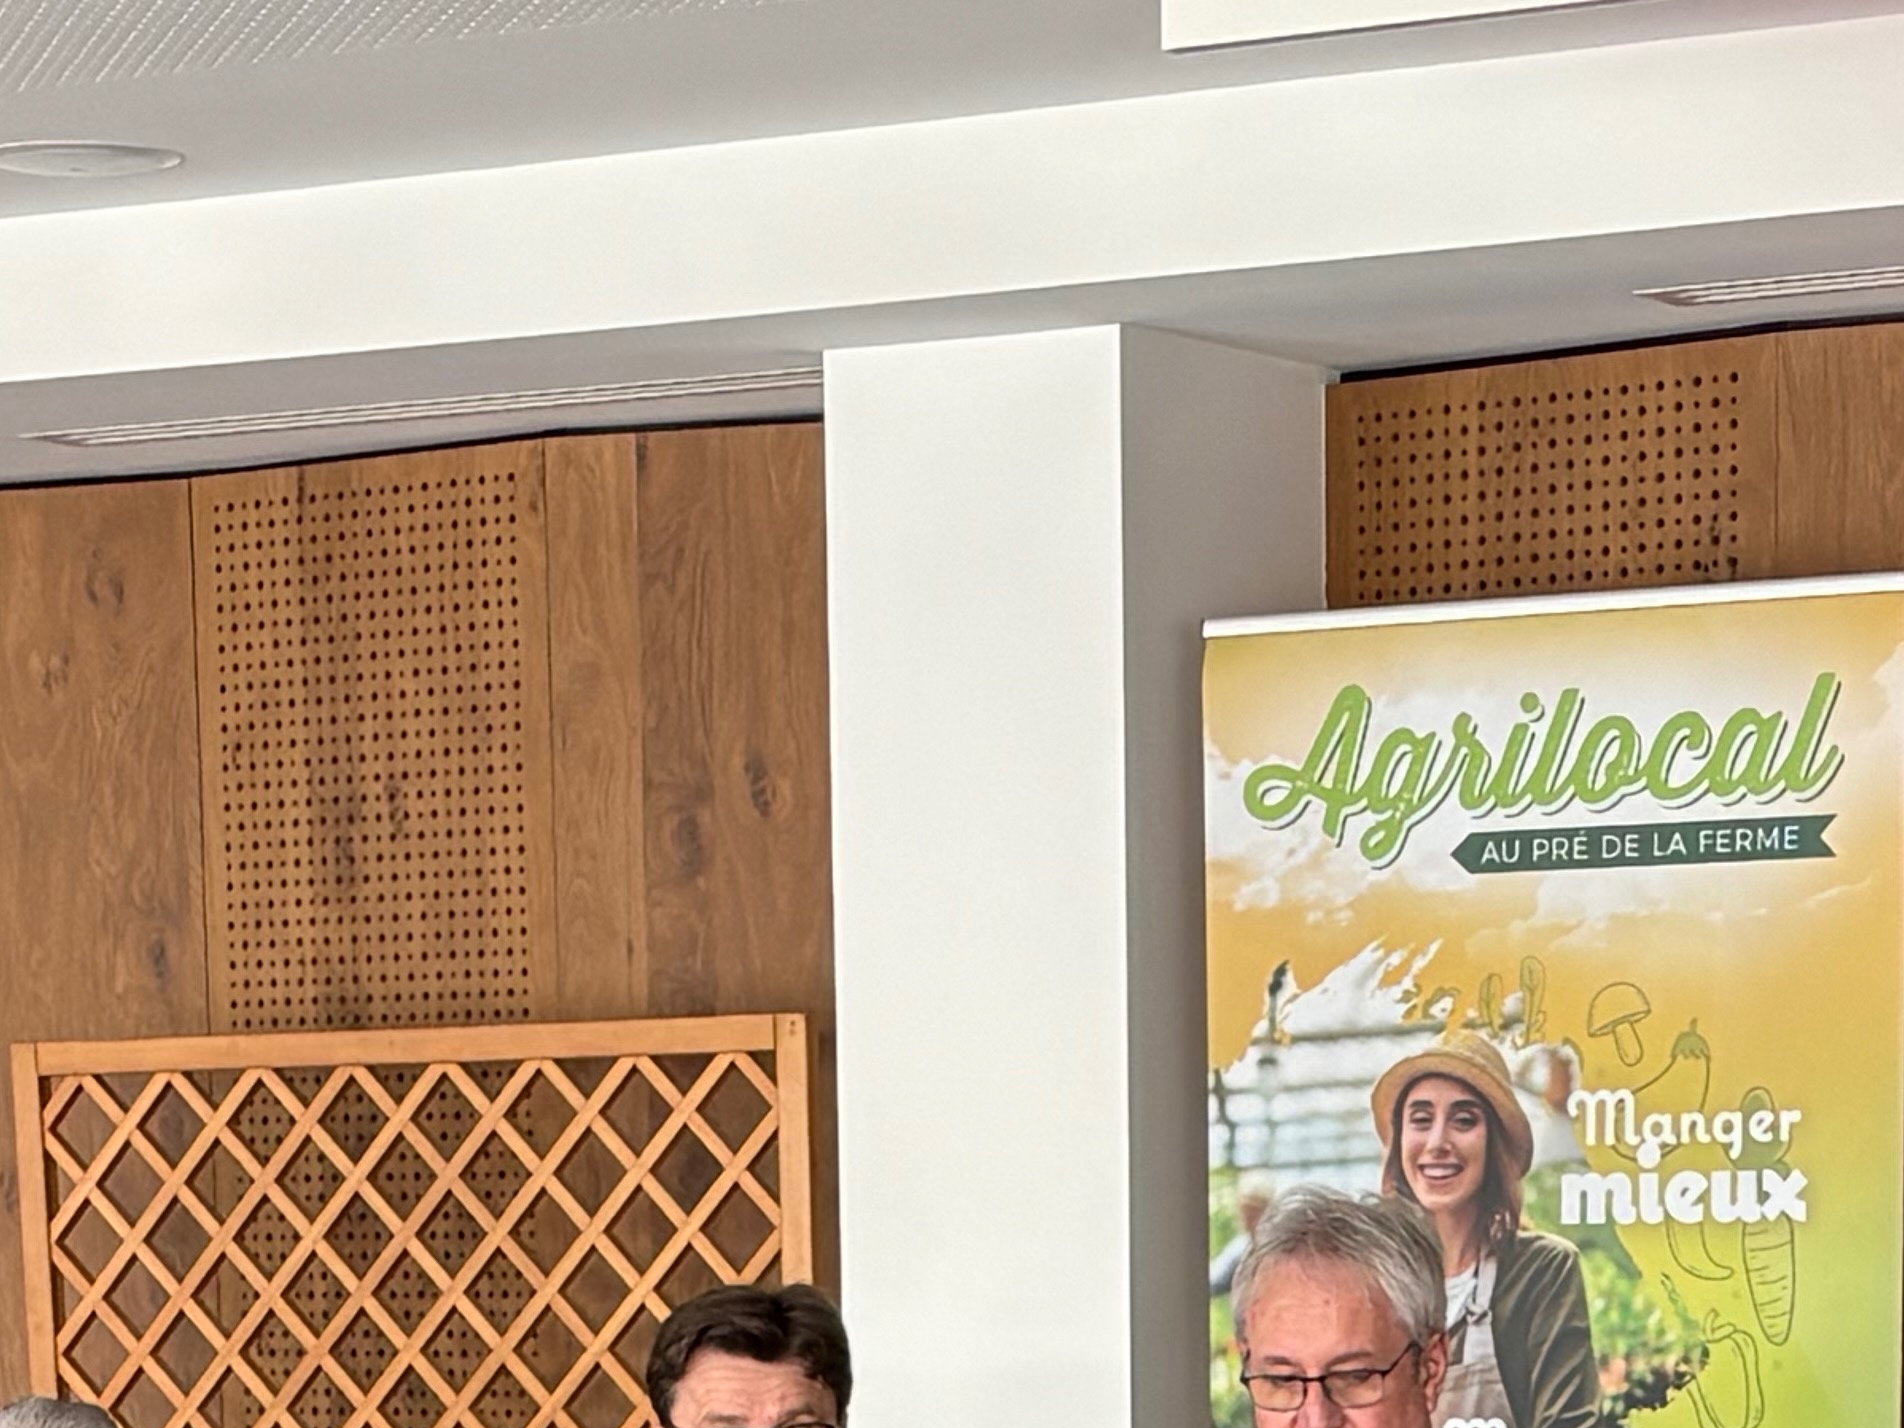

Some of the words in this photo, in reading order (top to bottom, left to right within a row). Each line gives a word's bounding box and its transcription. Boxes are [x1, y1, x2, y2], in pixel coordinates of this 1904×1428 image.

[1243, 672, 1845, 870] Agrilocal
[1481, 836, 1520, 865] AU
[1532, 829, 1588, 861] PRÉ
[1601, 833, 1640, 859] DE
[1653, 831, 1687, 857] LA
[1698, 825, 1800, 854] FERME
[1567, 1088, 1802, 1160] Manger
[1560, 1141, 1809, 1225] mieux
